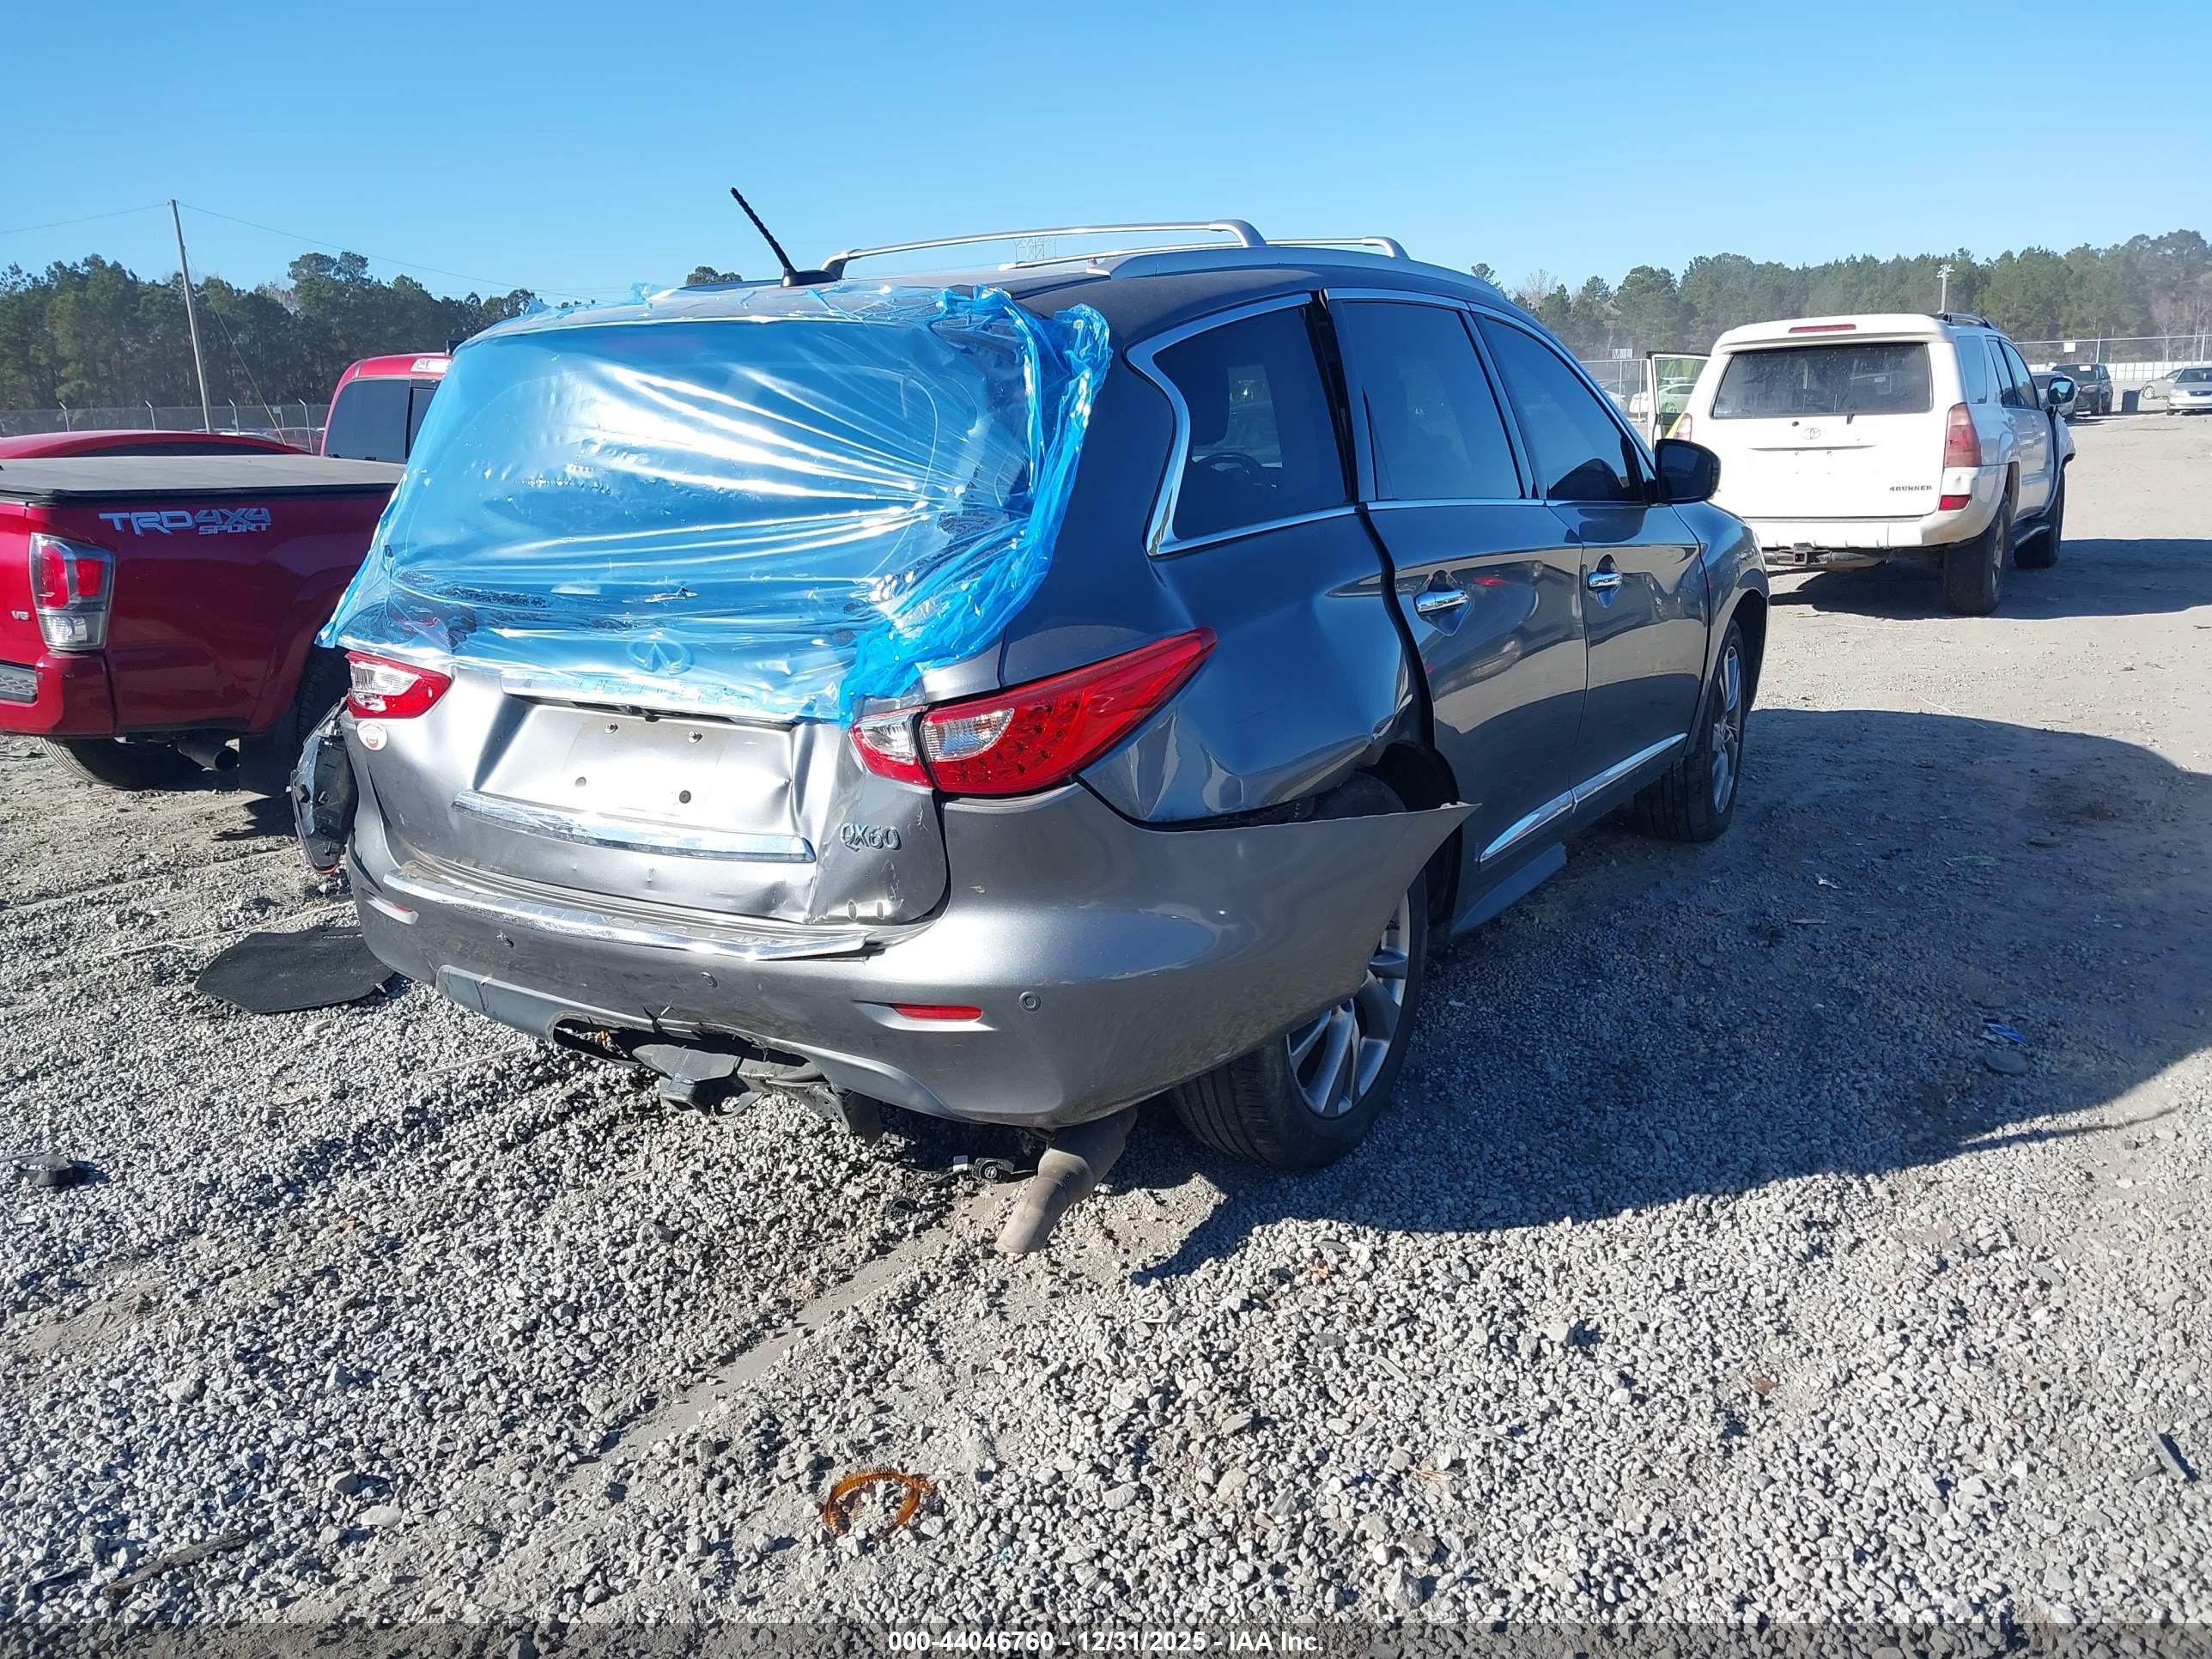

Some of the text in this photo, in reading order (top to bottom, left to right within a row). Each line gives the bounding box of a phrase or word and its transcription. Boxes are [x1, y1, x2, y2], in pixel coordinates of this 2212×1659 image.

[98, 510, 195, 537] TRD
[198, 522, 271, 535] SPORT
[840, 823, 902, 853] QX60
